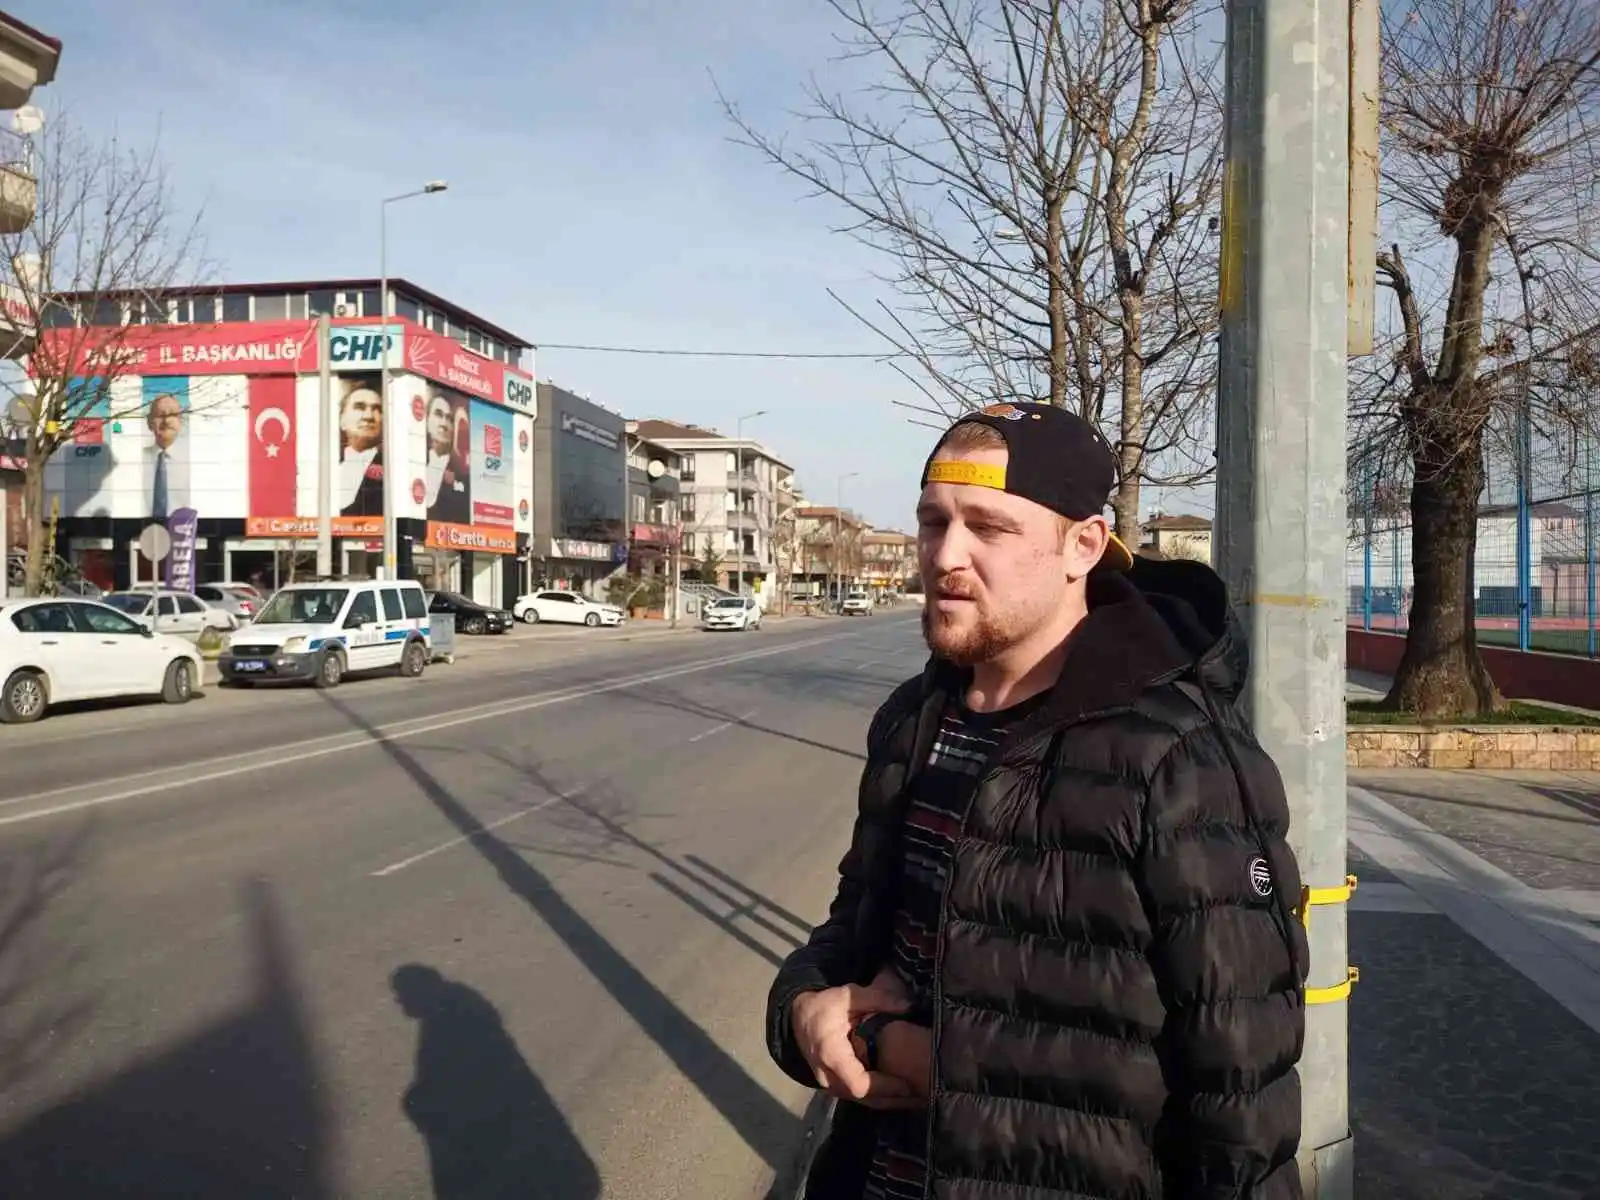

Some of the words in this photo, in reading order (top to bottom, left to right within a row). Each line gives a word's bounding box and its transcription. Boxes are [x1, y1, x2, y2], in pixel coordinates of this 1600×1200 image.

[181, 337, 303, 365] BAŞKANLIĞI
[330, 335, 392, 362] CHP
[507, 378, 532, 407] CHP
